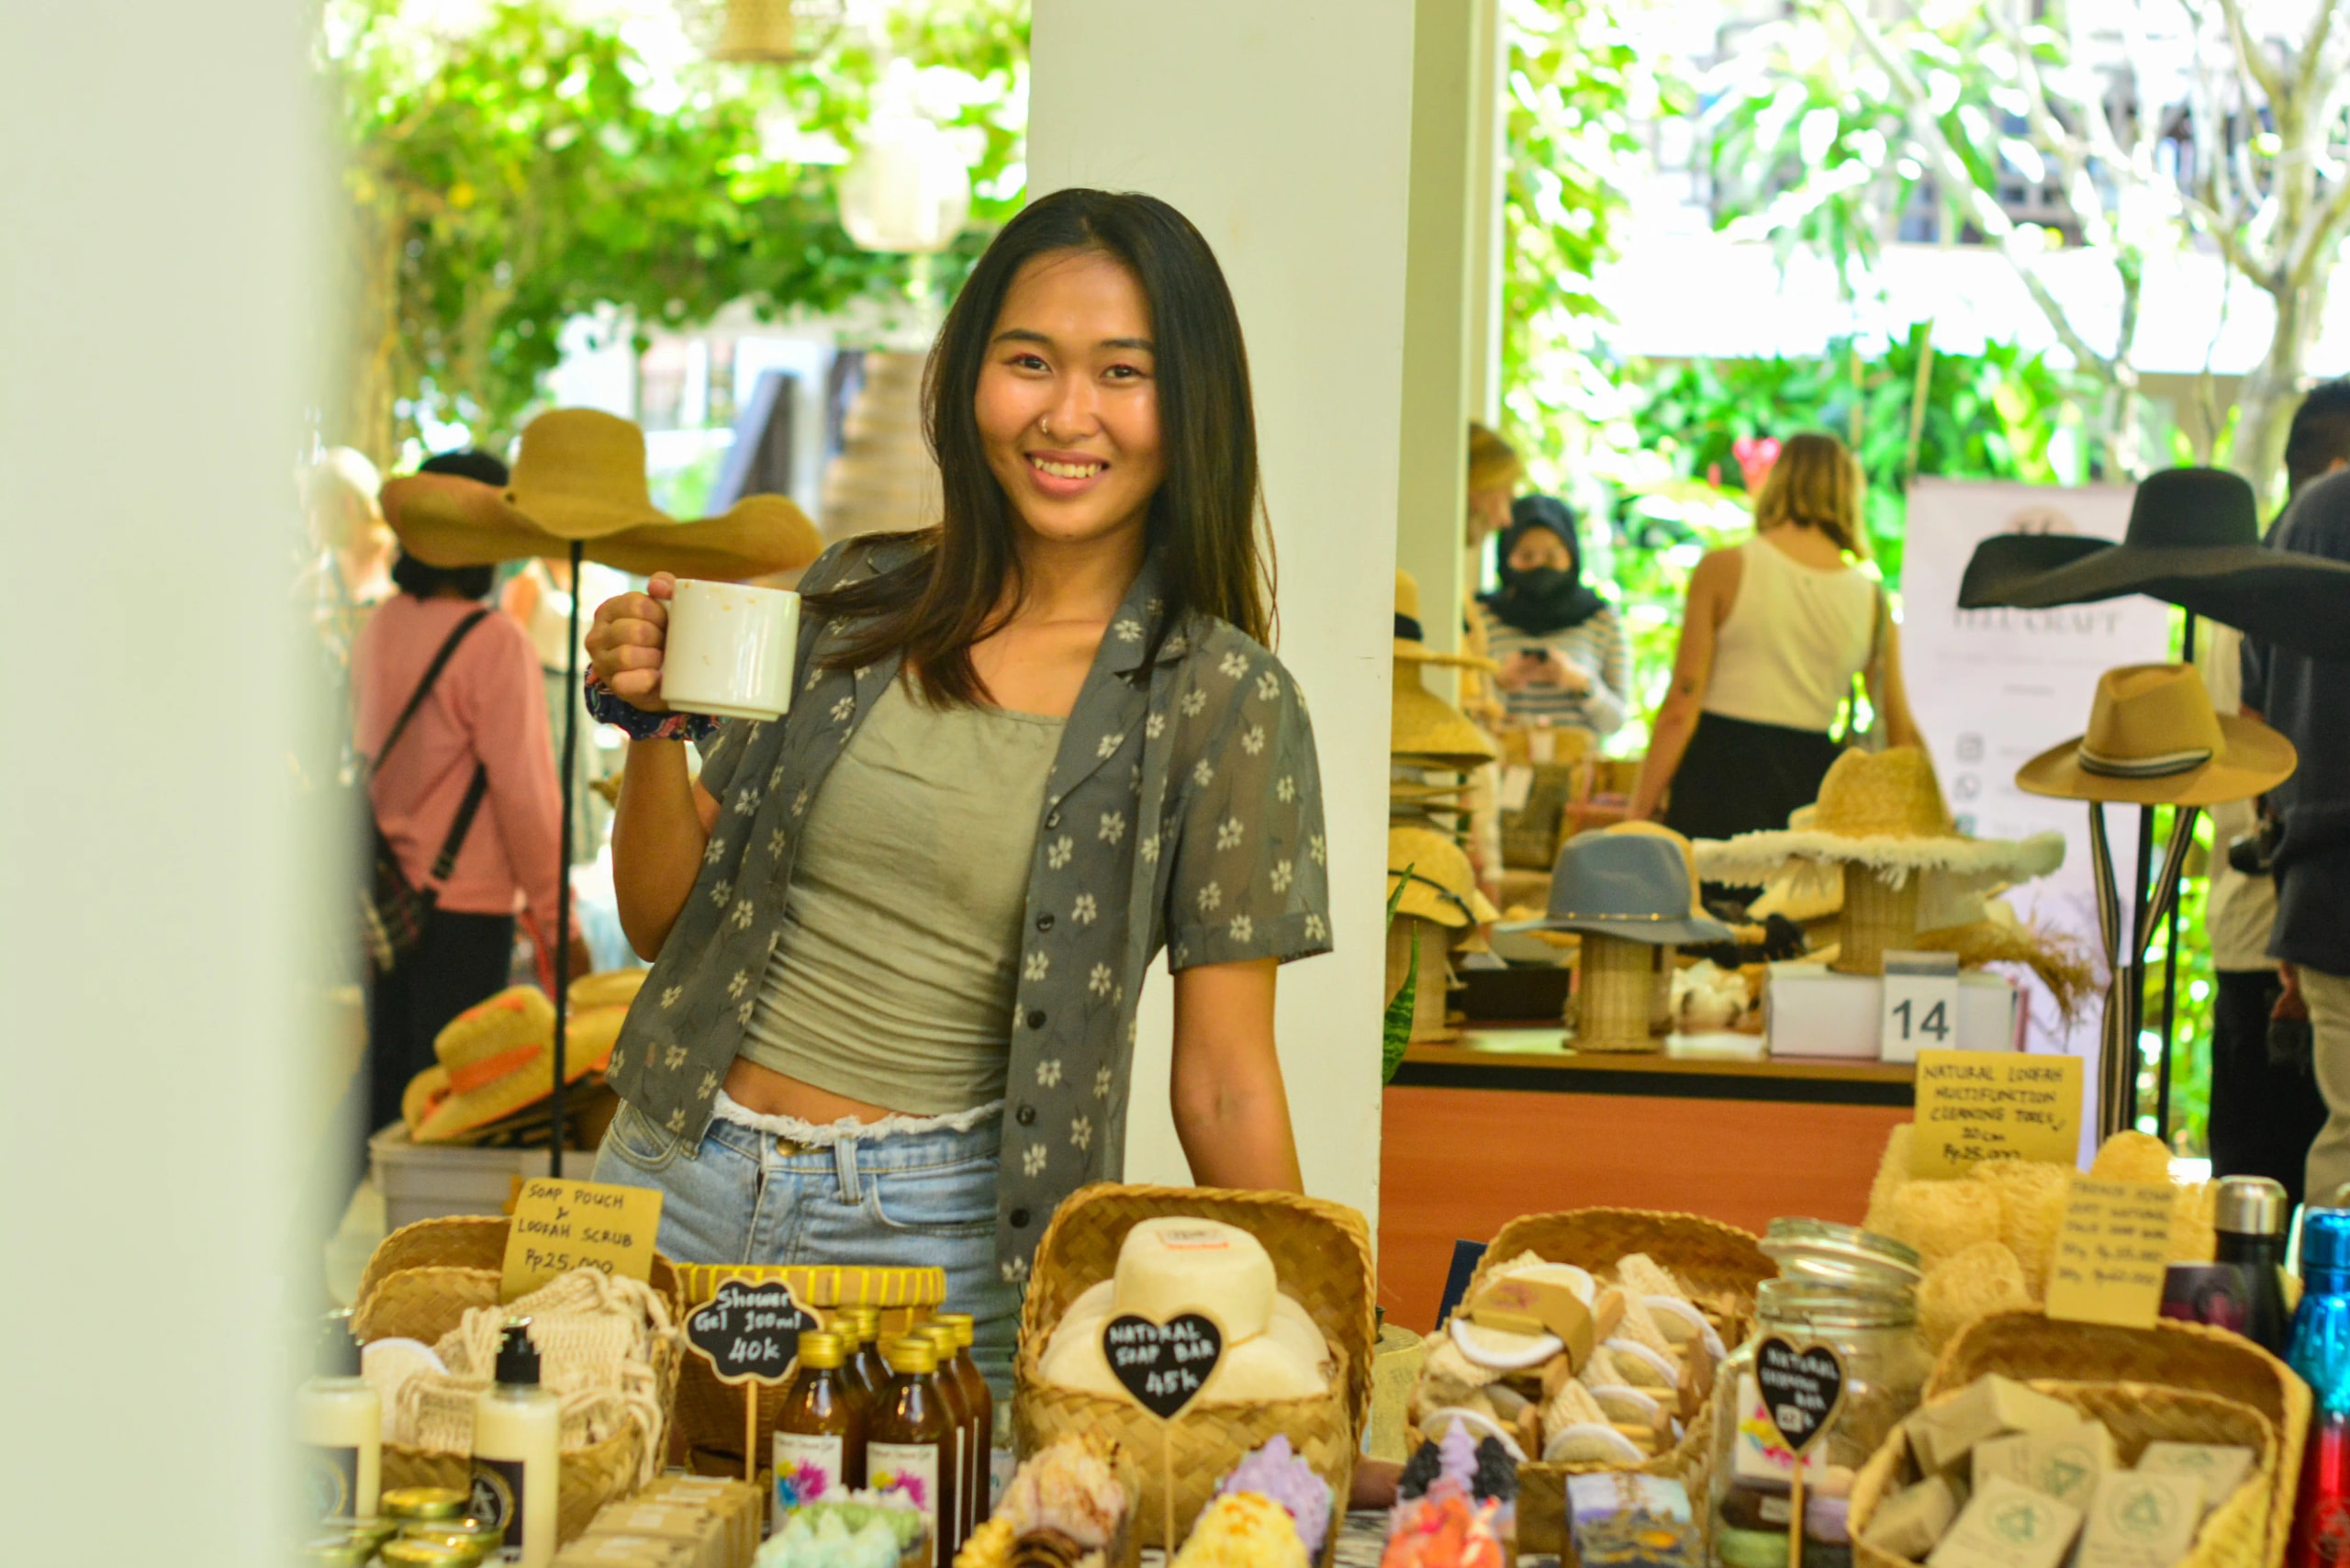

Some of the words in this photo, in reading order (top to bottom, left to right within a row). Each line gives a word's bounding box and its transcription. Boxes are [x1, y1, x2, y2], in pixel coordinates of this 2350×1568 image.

[1893, 999, 1950, 1041] 14
[1924, 1064, 1995, 1081] NATURAL
[528, 1183, 563, 1201] SOAP
[574, 1190, 624, 1209] POUCH
[518, 1218, 571, 1238] LOOFAH
[579, 1226, 632, 1248] SCRUB
[716, 1287, 789, 1310] Shower
[695, 1311, 728, 1332] Gel
[1110, 1321, 1202, 1345] NATURAL
[1116, 1343, 1160, 1366] SOAP
[1173, 1338, 1215, 1362] BAR
[1767, 1347, 1839, 1381] NATURAL
